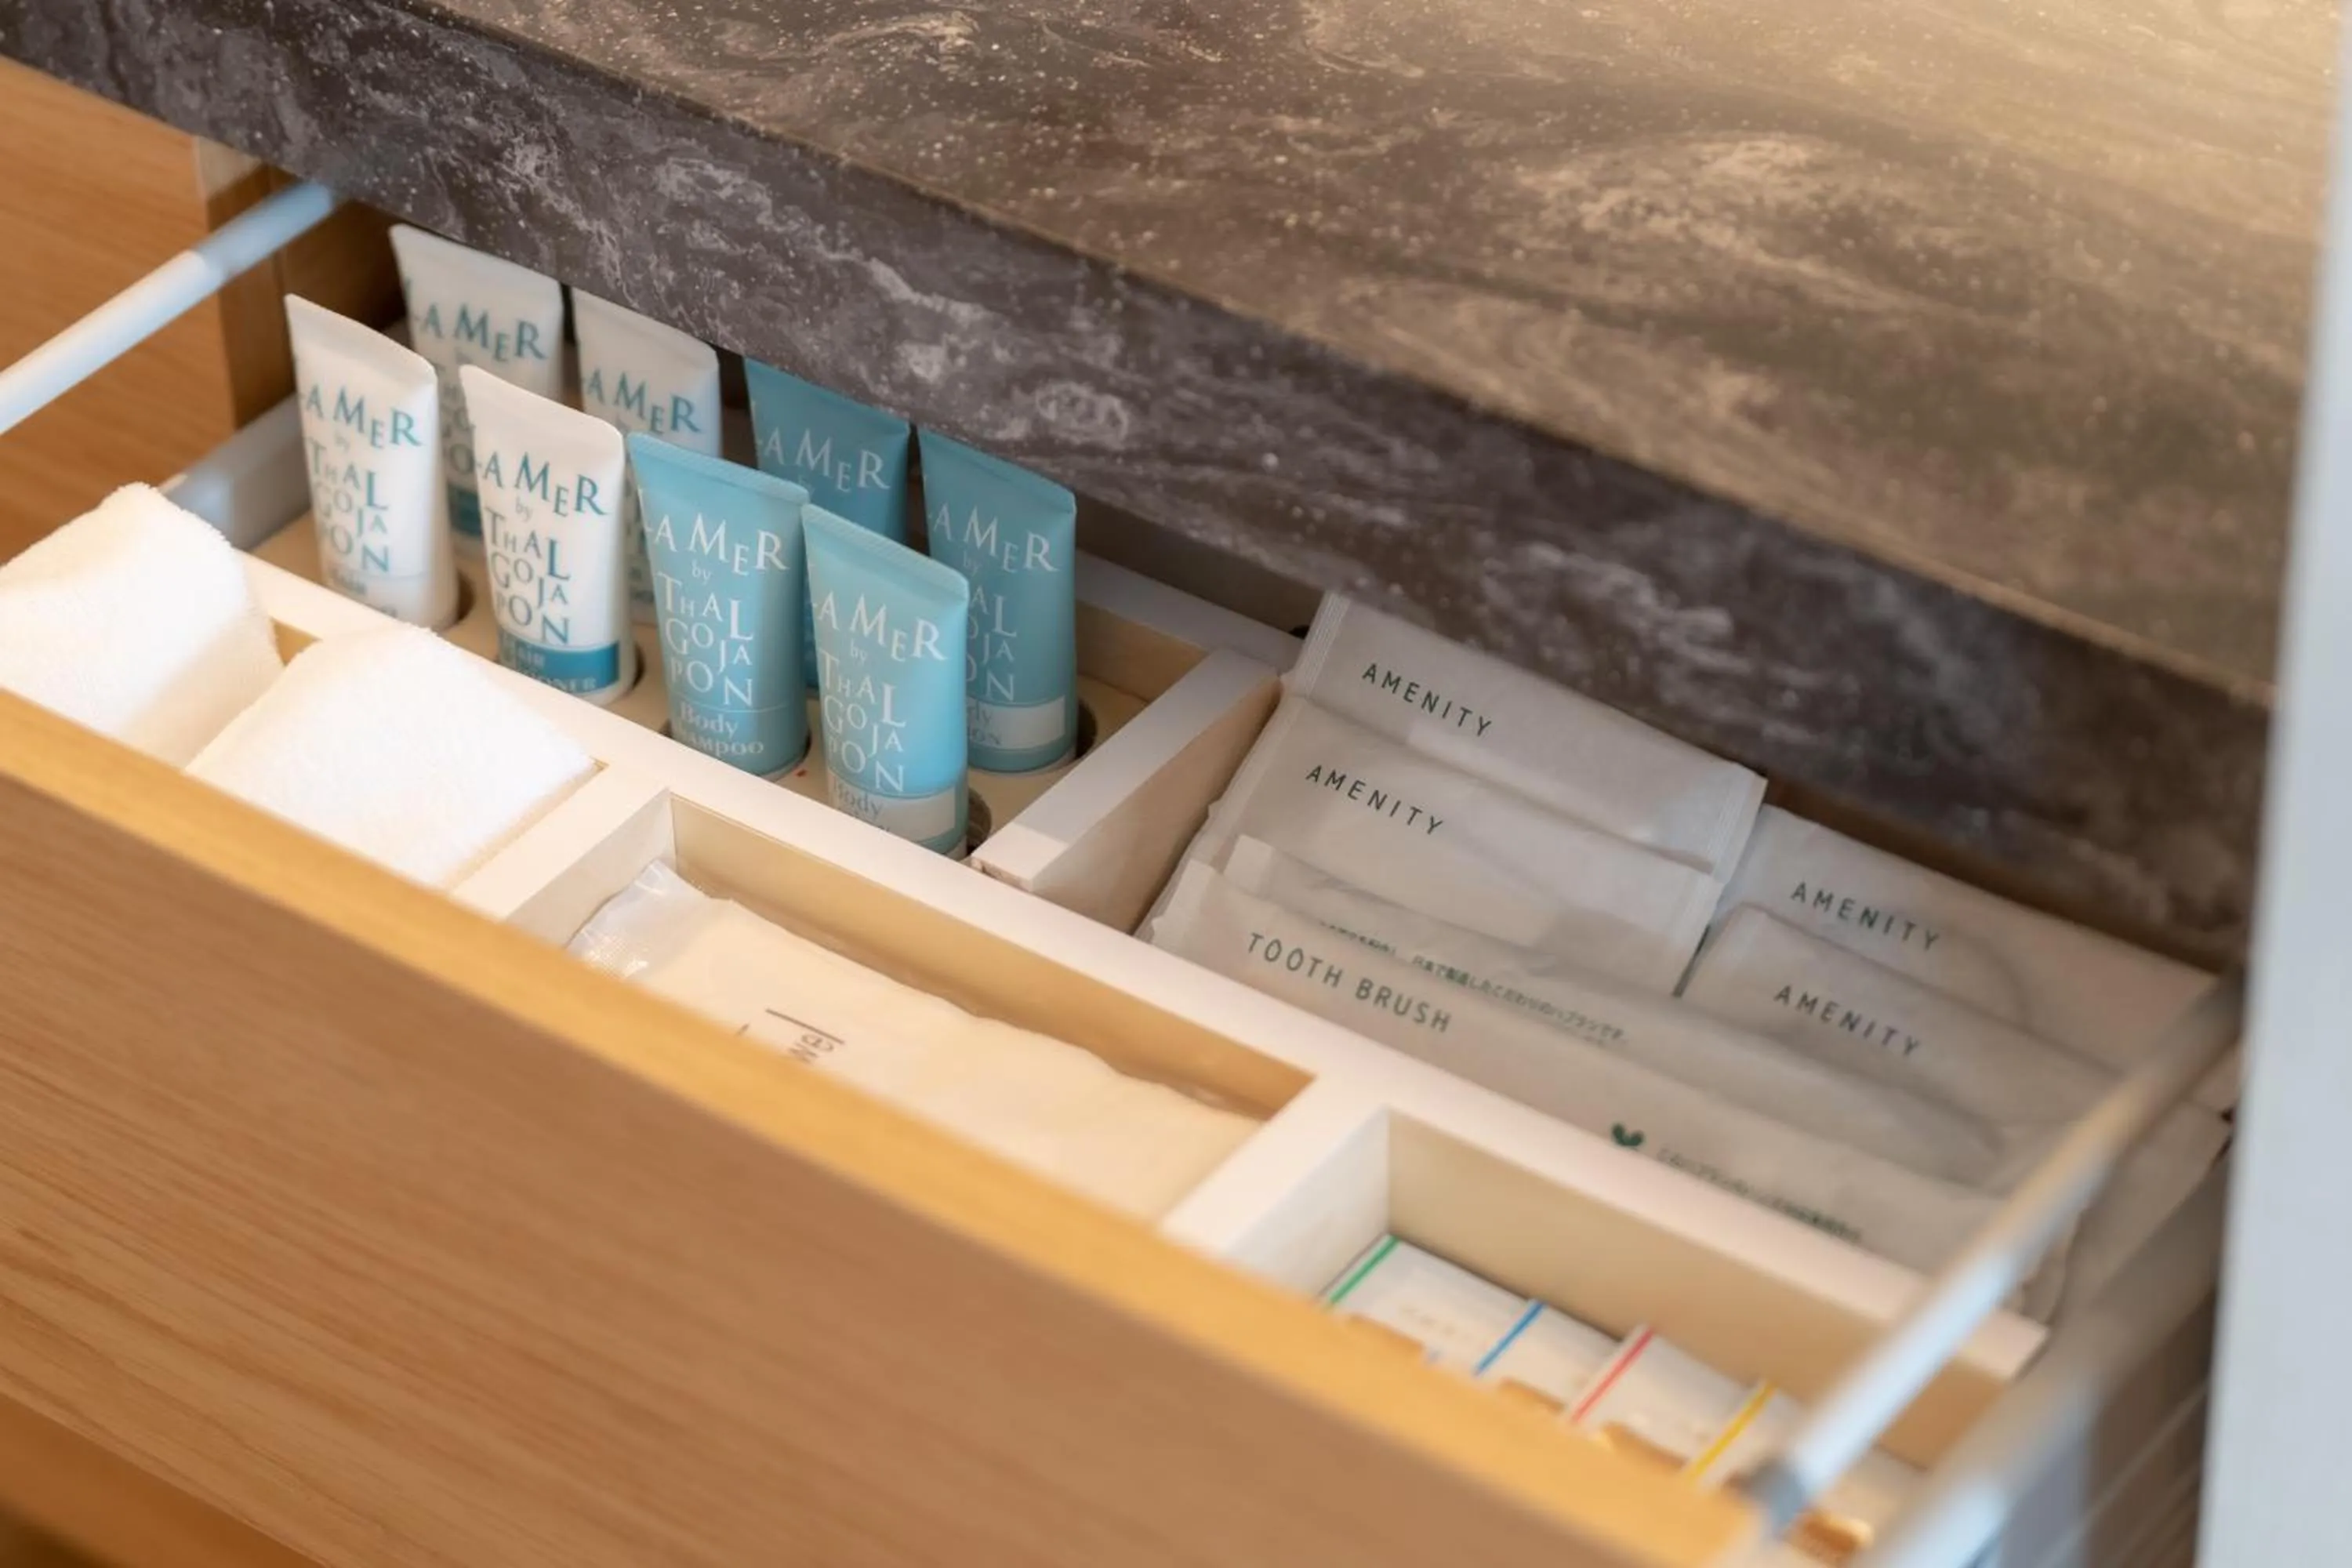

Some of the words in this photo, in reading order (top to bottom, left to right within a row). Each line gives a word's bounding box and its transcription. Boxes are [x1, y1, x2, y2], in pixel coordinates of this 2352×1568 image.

[1363, 663, 1492, 737] AMENITY
[1305, 764, 1444, 836] AMENITY
[1791, 880, 1940, 951] AMENITY
[1247, 931, 1343, 989] TOOTH
[1354, 977, 1452, 1033] BRUSH
[1773, 984, 1920, 1056] AMENITY
